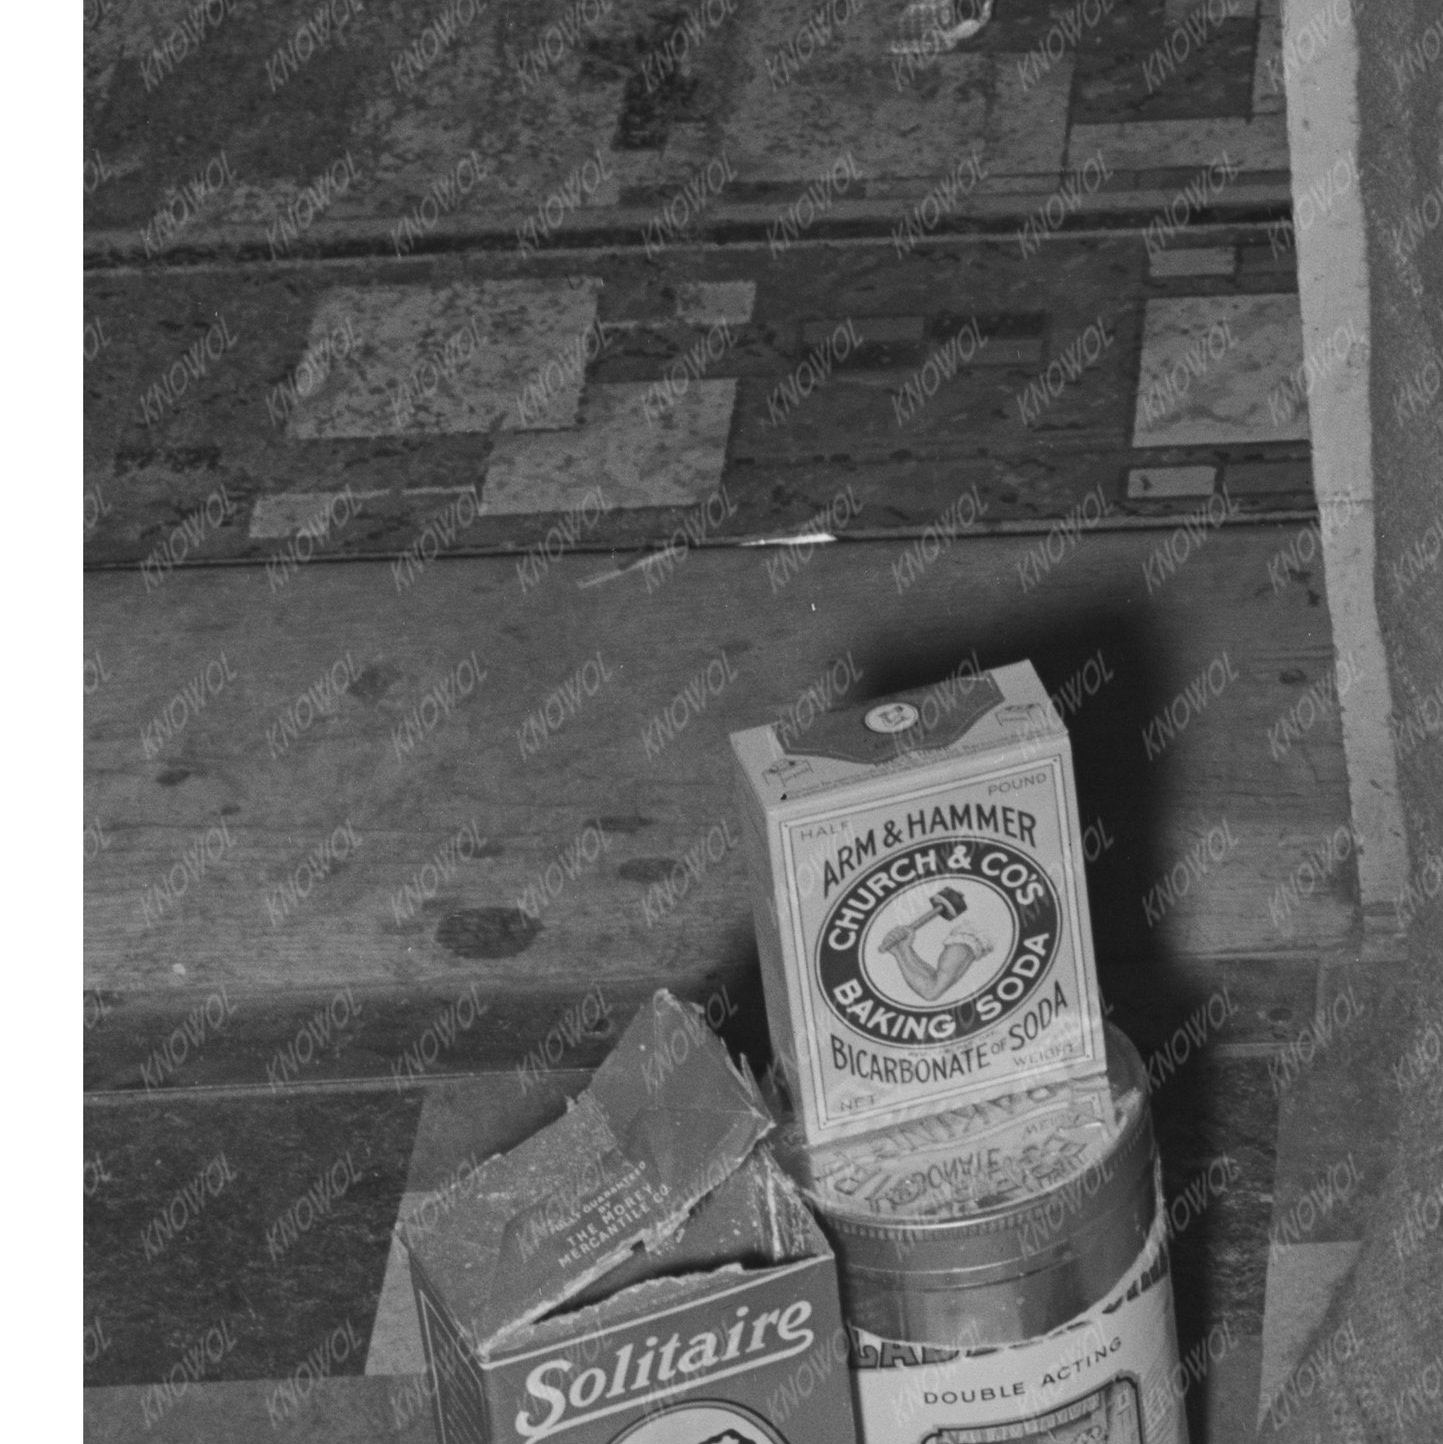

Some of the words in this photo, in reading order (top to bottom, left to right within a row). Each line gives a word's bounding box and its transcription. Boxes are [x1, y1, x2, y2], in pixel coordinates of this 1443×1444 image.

[987, 772, 1049, 797] POUND
[823, 828, 877, 900] ARM
[882, 819, 904, 849] &
[906, 802, 1038, 849] HAMMER
[827, 848, 938, 952] CHURCH
[947, 844, 972, 871] &
[833, 977, 957, 1040] BAKING
[975, 932, 1051, 1022] SODA
[829, 1032, 992, 1085] BICARBONATE
[1008, 979, 1070, 1052] SODA
[557, 1201, 651, 1269] MERCANTILE
[566, 1222, 599, 1247] THE
[601, 1183, 653, 1225] MOREY
[923, 1381, 1027, 1406] DOUBLE
[1040, 1335, 1123, 1389] ACTING
